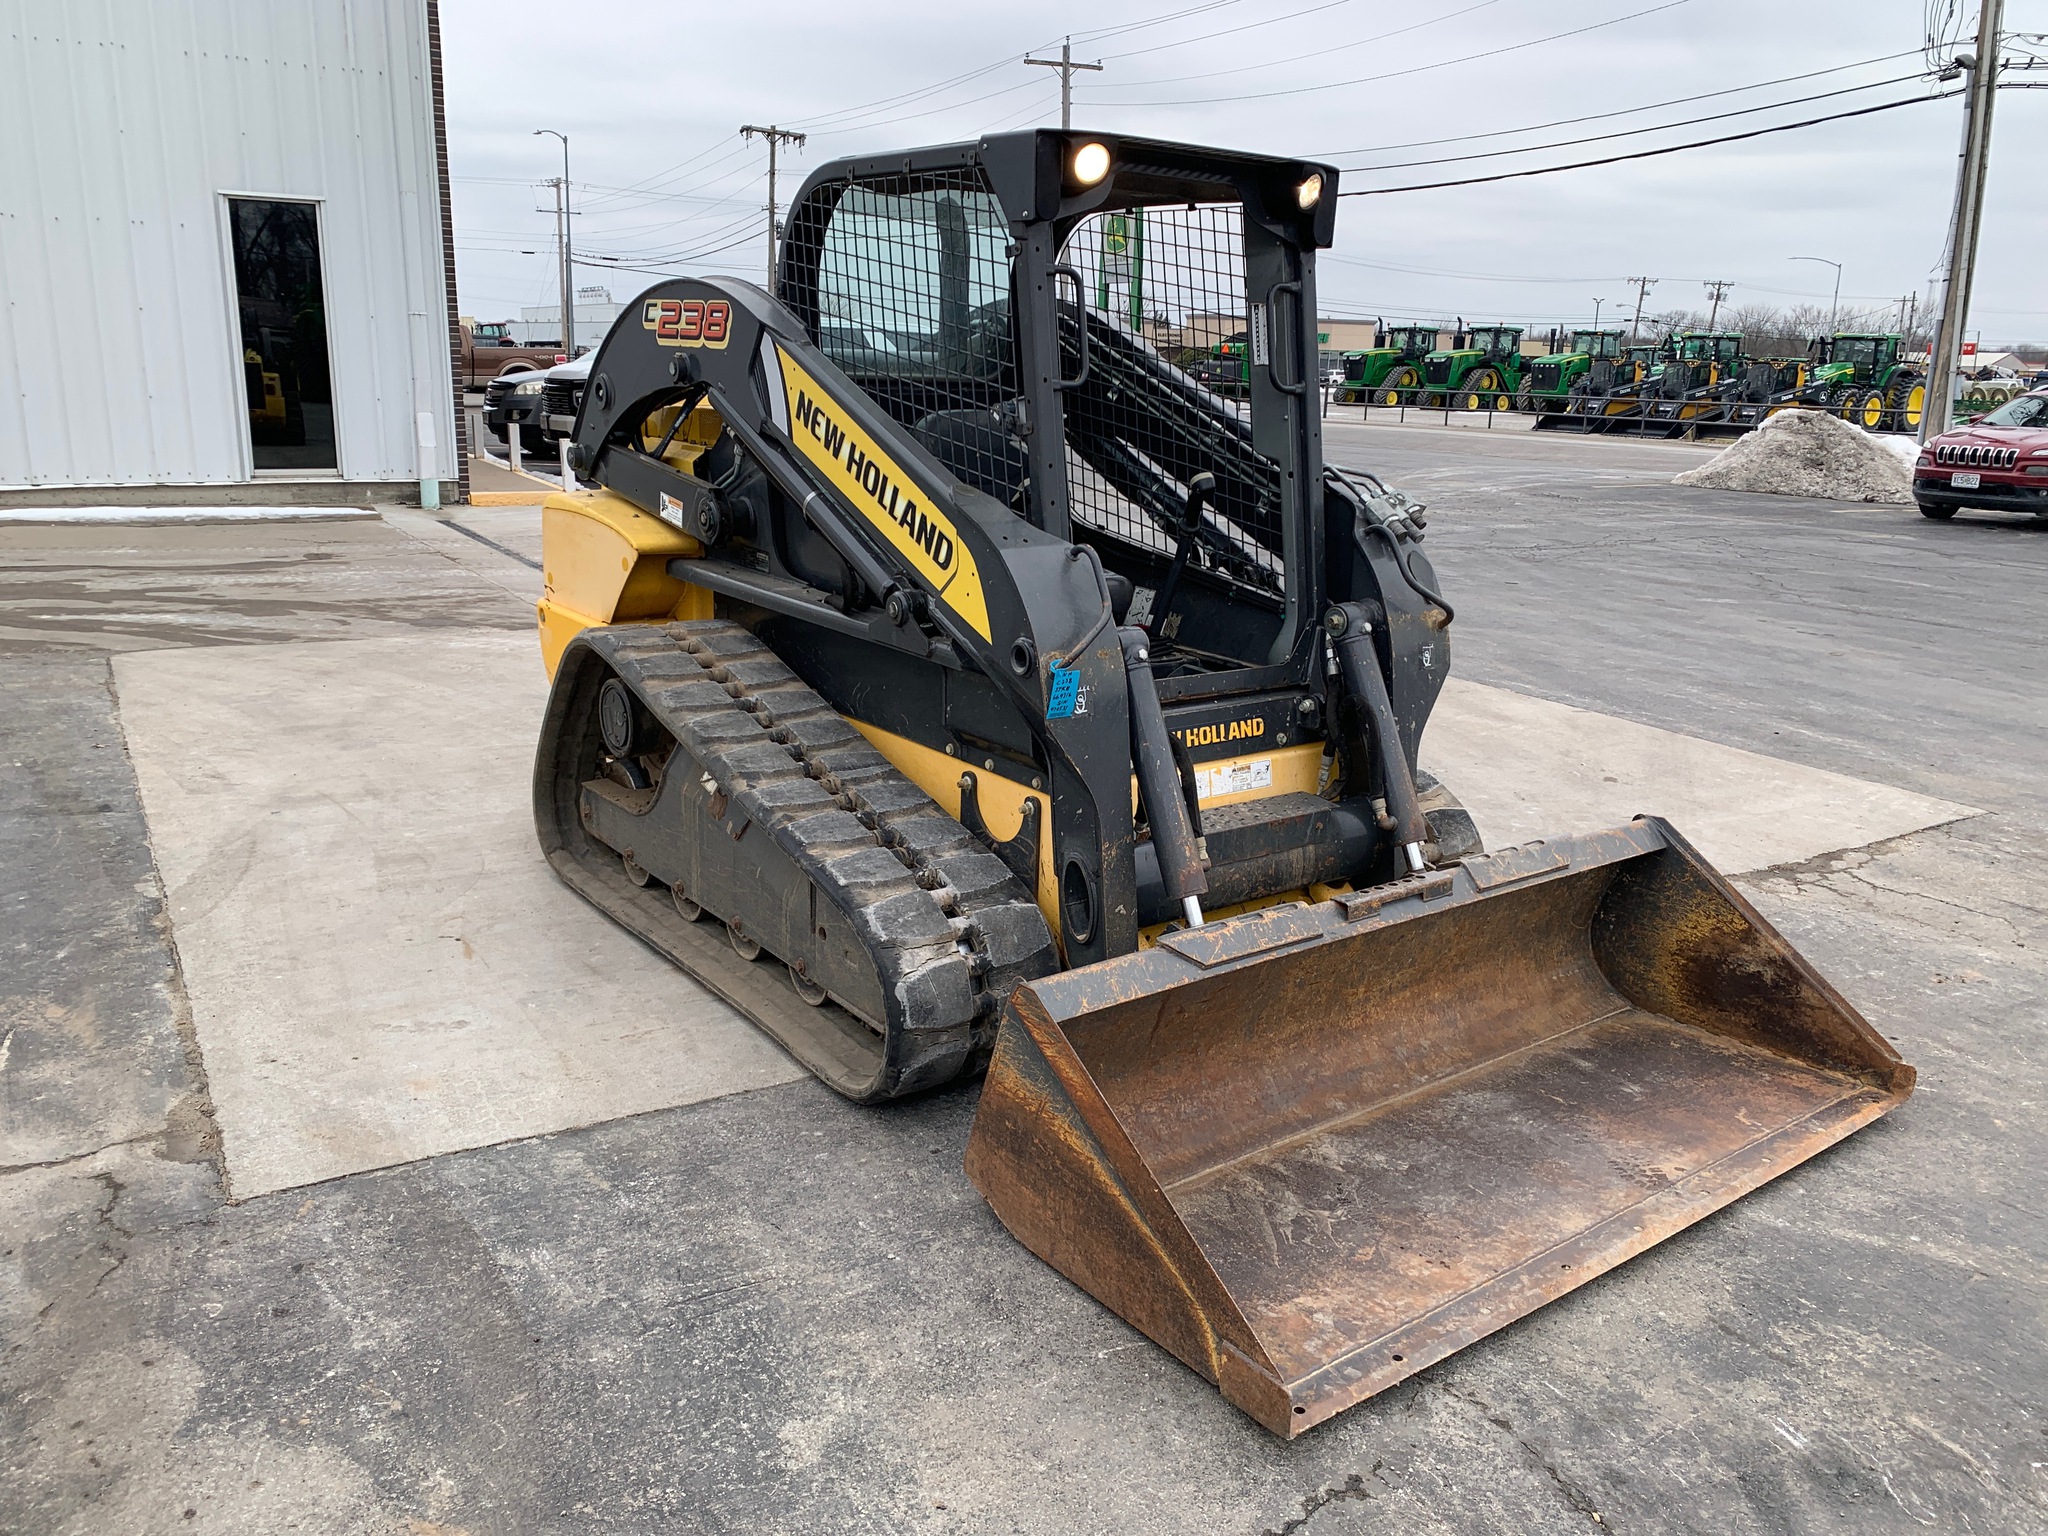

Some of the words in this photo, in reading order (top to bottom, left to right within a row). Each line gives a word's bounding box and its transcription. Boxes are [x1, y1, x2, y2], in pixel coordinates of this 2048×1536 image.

[643, 302, 729, 342] C238
[795, 389, 846, 460] NEW
[846, 441, 953, 571] HOLLAND
[1185, 717, 1265, 748] HOLLAND
